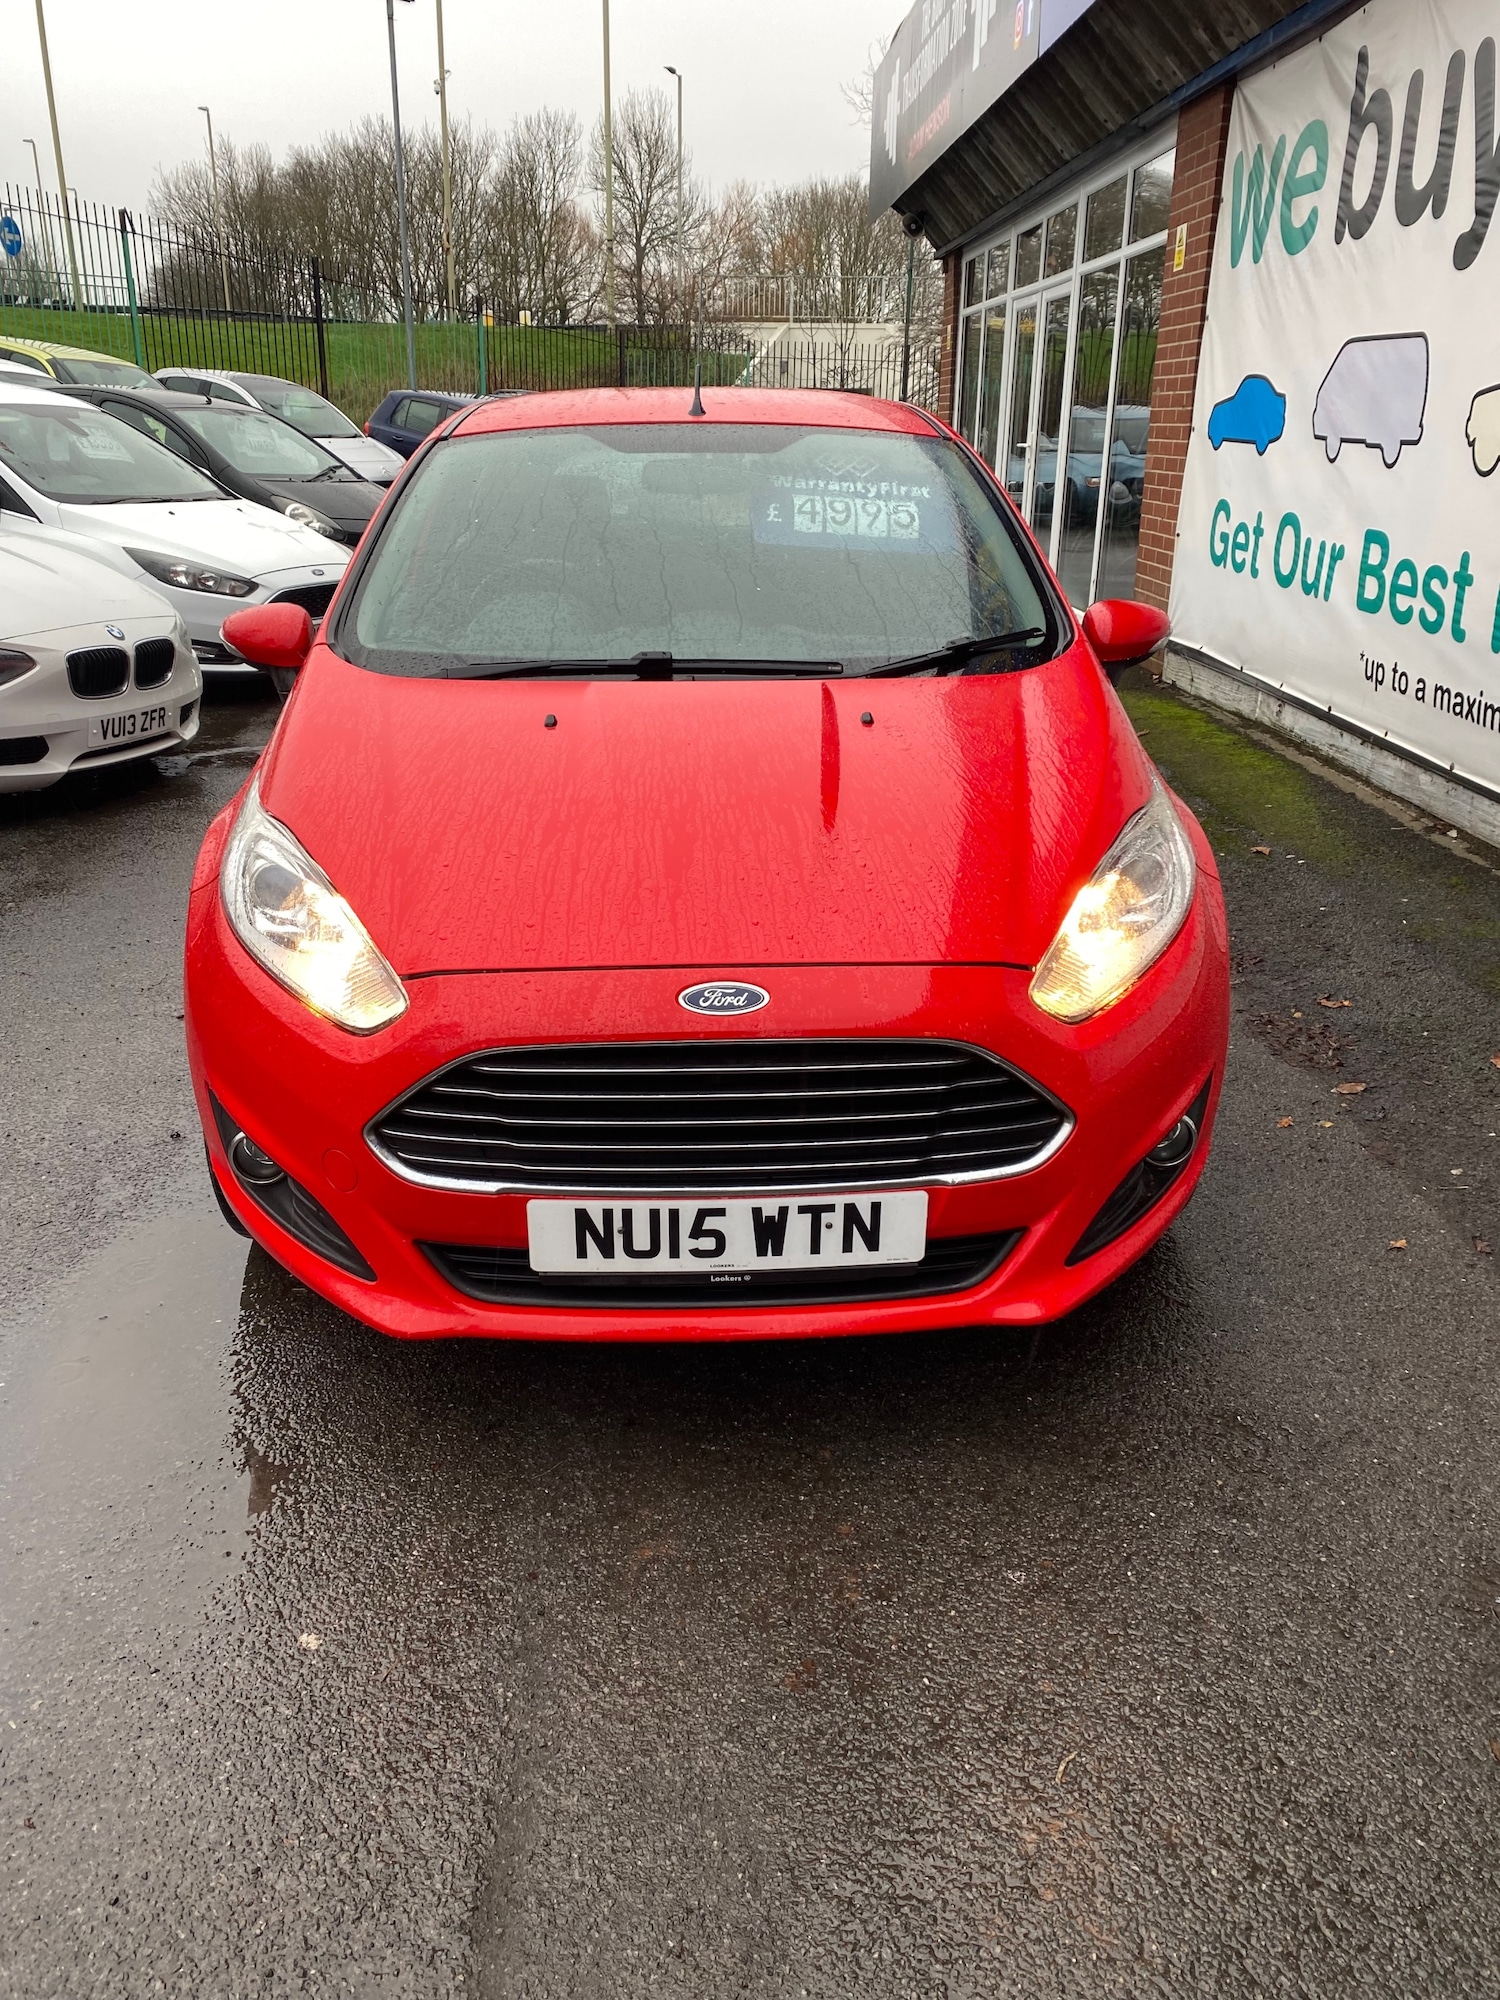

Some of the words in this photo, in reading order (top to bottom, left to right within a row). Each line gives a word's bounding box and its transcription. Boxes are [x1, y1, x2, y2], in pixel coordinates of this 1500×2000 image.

[1210, 498, 1264, 579] Get
[1273, 512, 1345, 602] Our
[1356, 529, 1474, 643] Best
[1392, 662, 1409, 695] to
[1415, 677, 1426, 703] a
[100, 715, 136, 740] VU13
[140, 707, 166, 732] ZFR
[699, 988, 748, 1007] Ford
[575, 1208, 726, 1259] NU15
[751, 1202, 881, 1257] WTN
